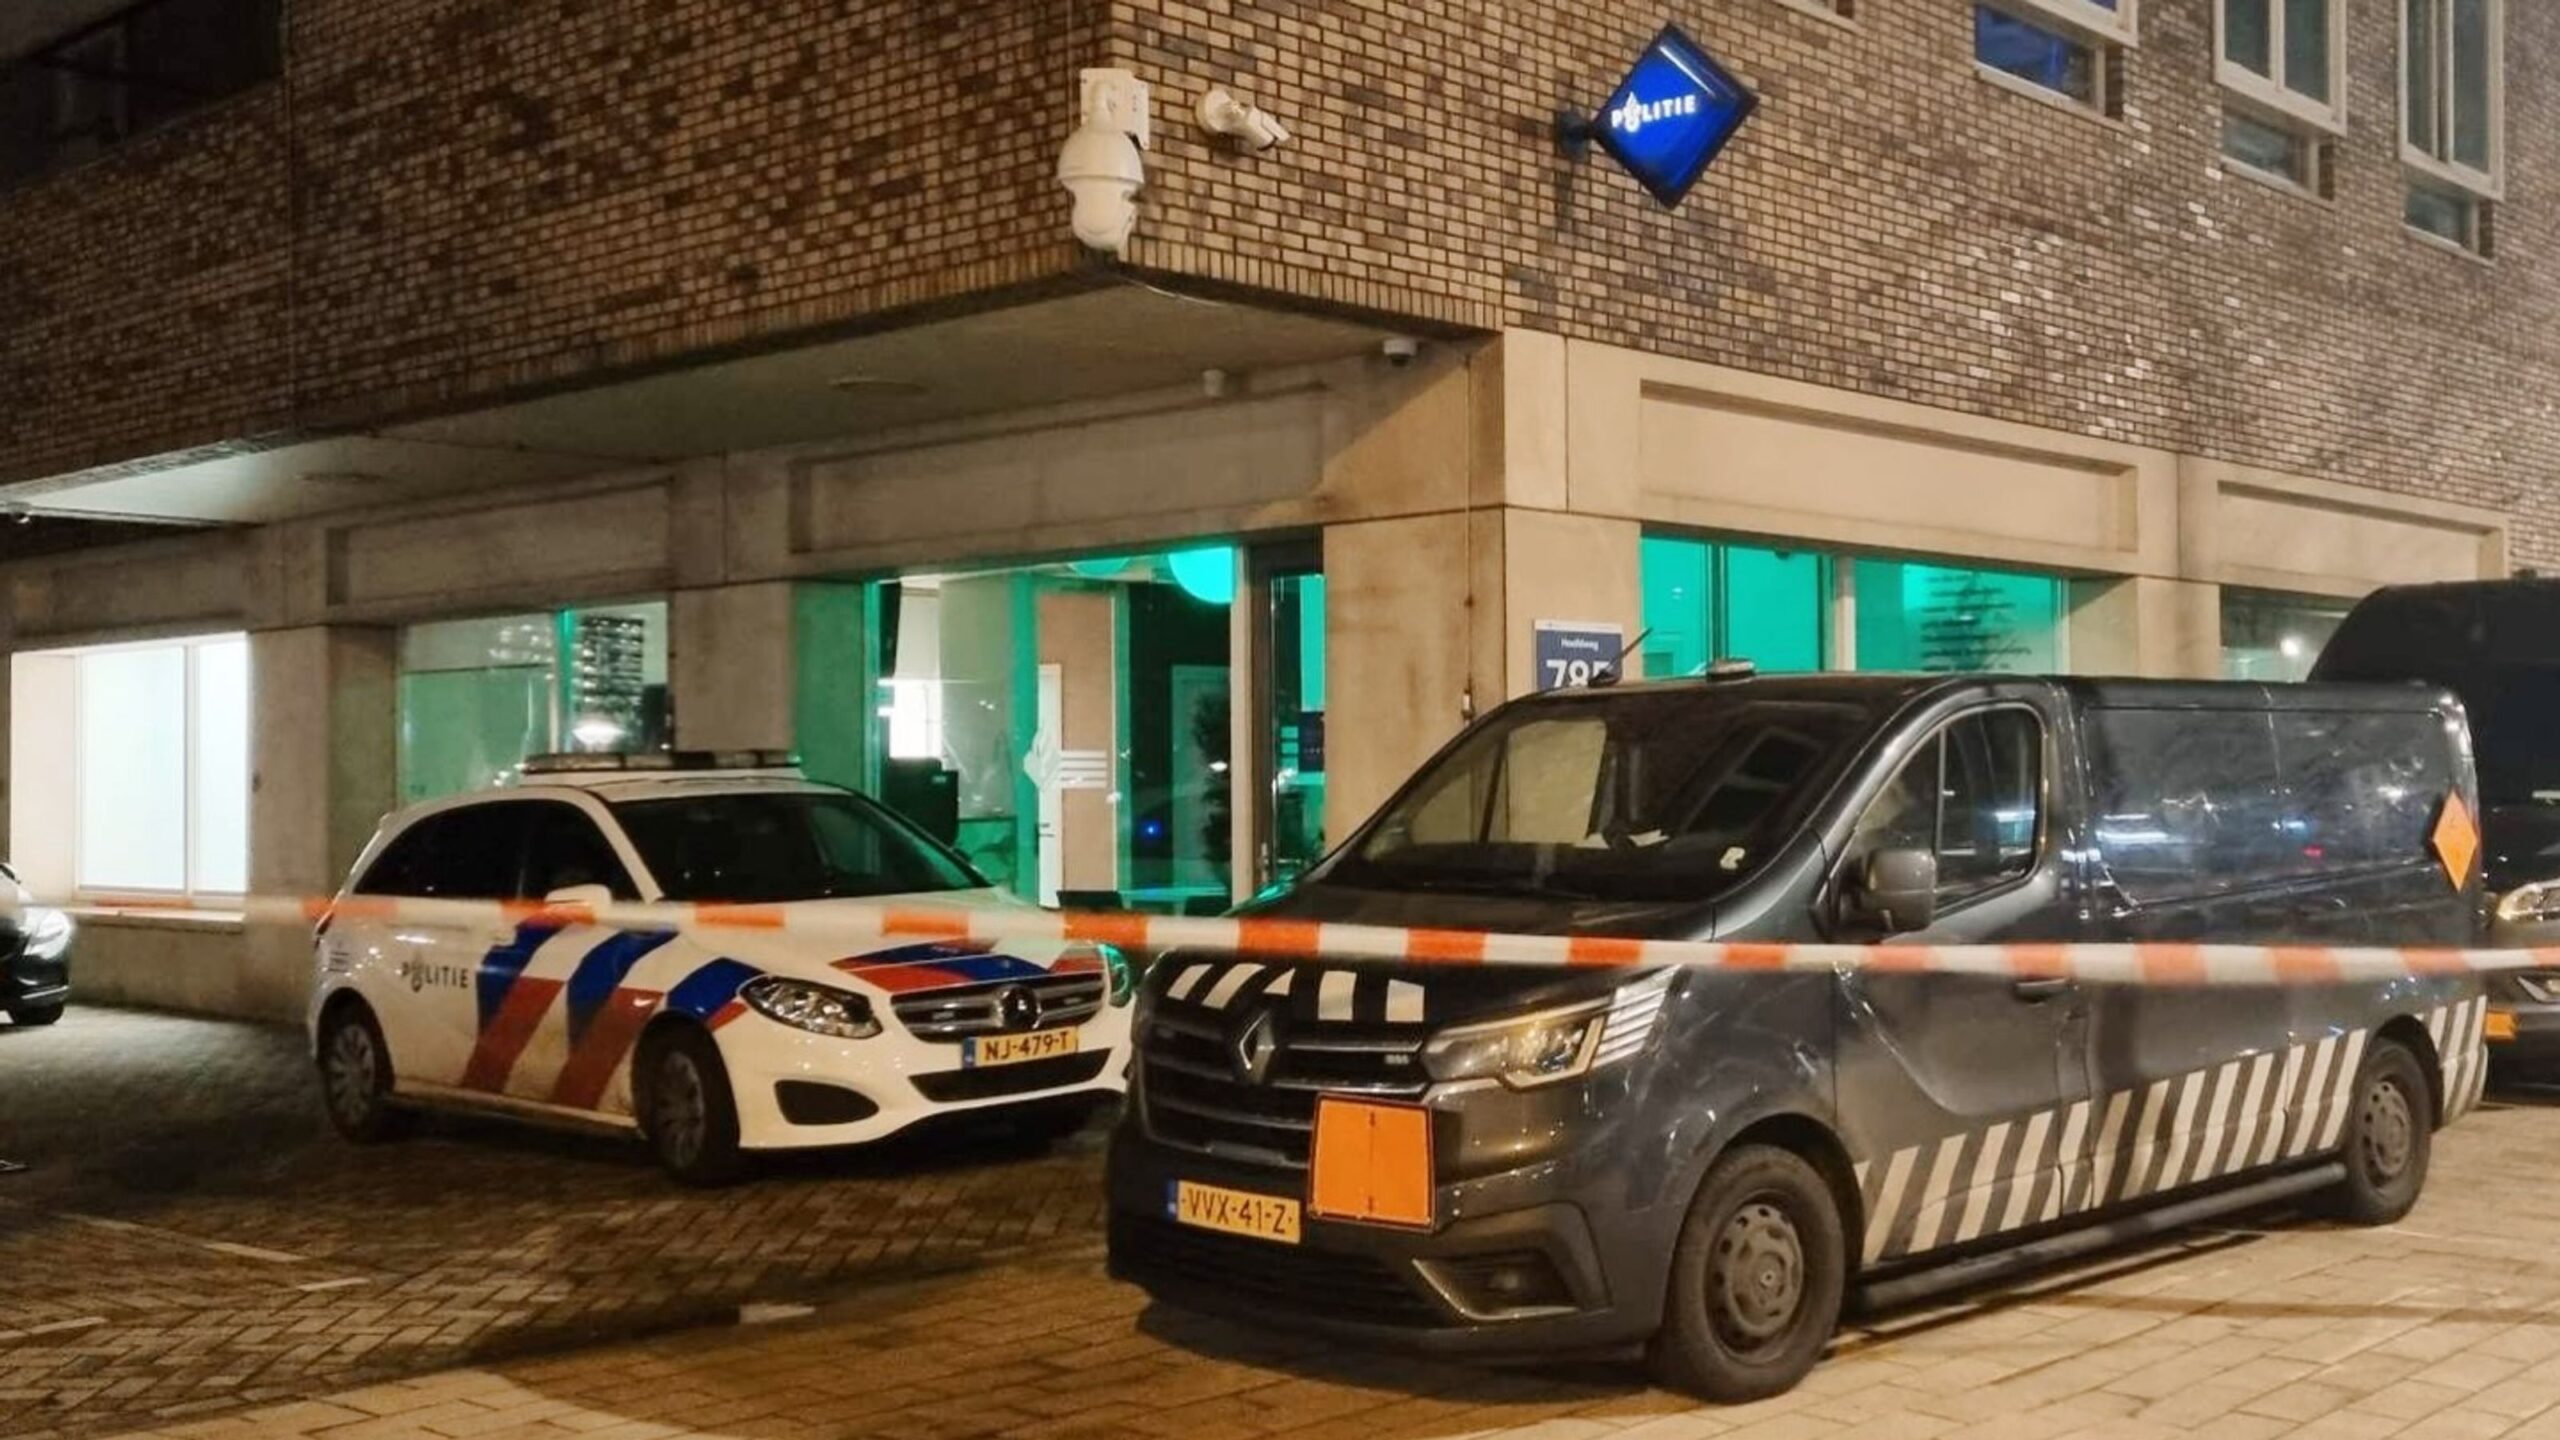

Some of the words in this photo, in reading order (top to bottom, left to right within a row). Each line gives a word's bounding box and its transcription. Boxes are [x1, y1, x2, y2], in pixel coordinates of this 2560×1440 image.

[1611, 91, 1696, 133] POLITIE
[402, 957, 469, 993] POLITIE
[985, 1031, 1069, 1061] NJ-479-T
[1188, 1187, 1286, 1235] VVX-41-Z
